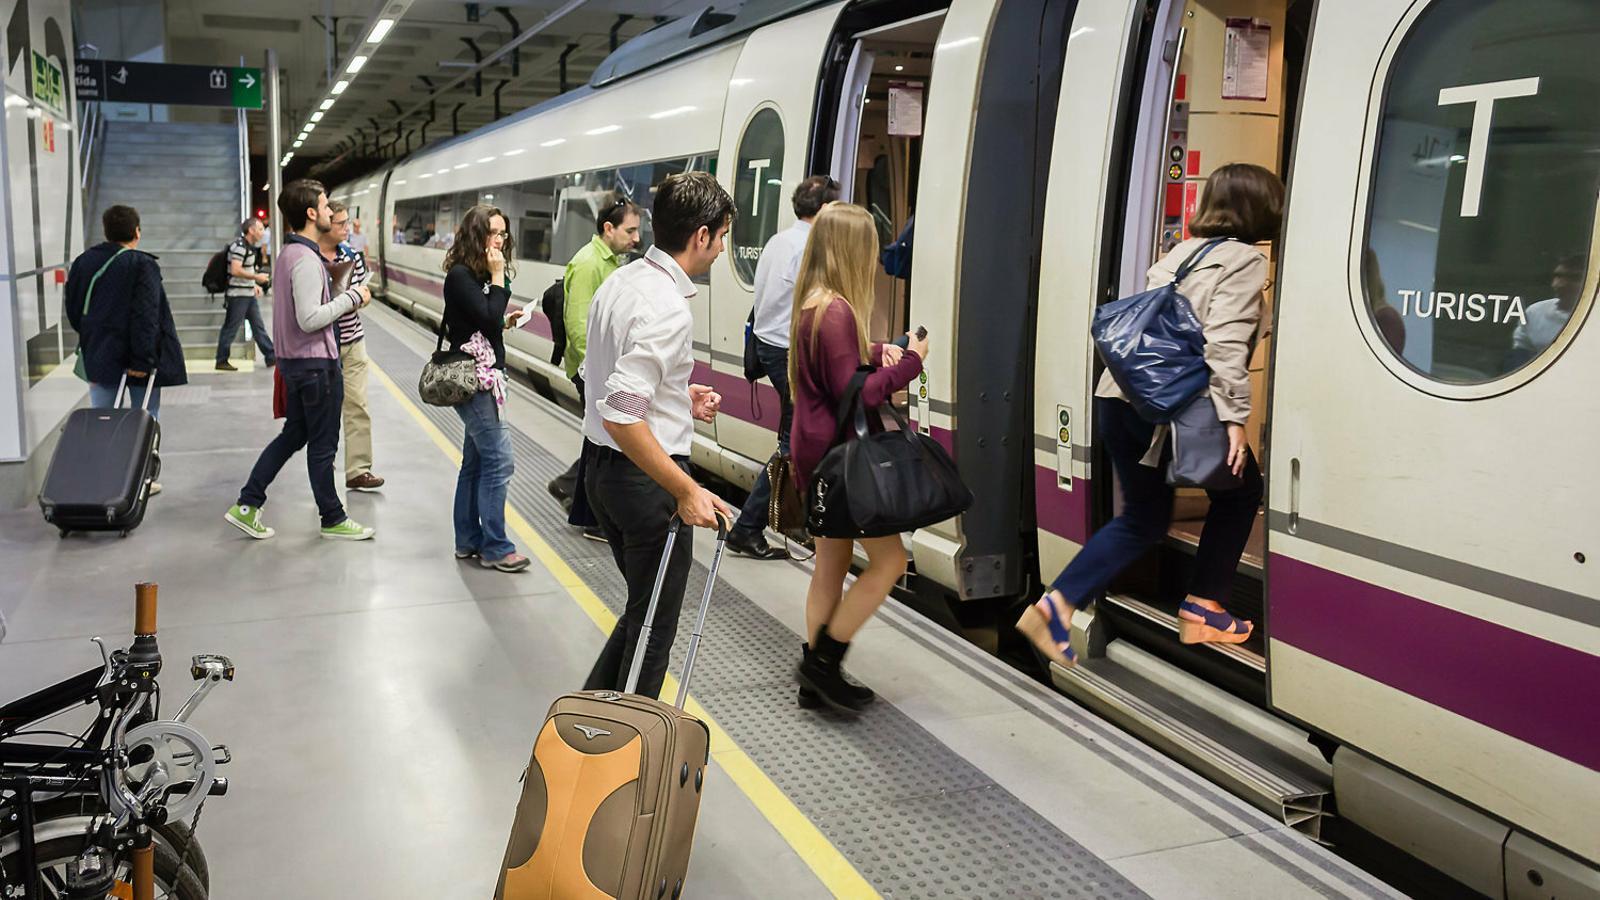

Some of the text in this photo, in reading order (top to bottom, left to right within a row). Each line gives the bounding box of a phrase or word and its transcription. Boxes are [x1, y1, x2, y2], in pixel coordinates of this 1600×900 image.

[77, 64, 90, 73] da
[76, 76, 97, 86] tida
[1438, 76, 1540, 217] T
[749, 158, 770, 216] T
[739, 246, 762, 259] TURIST
[1398, 289, 1527, 325] TURISTA
